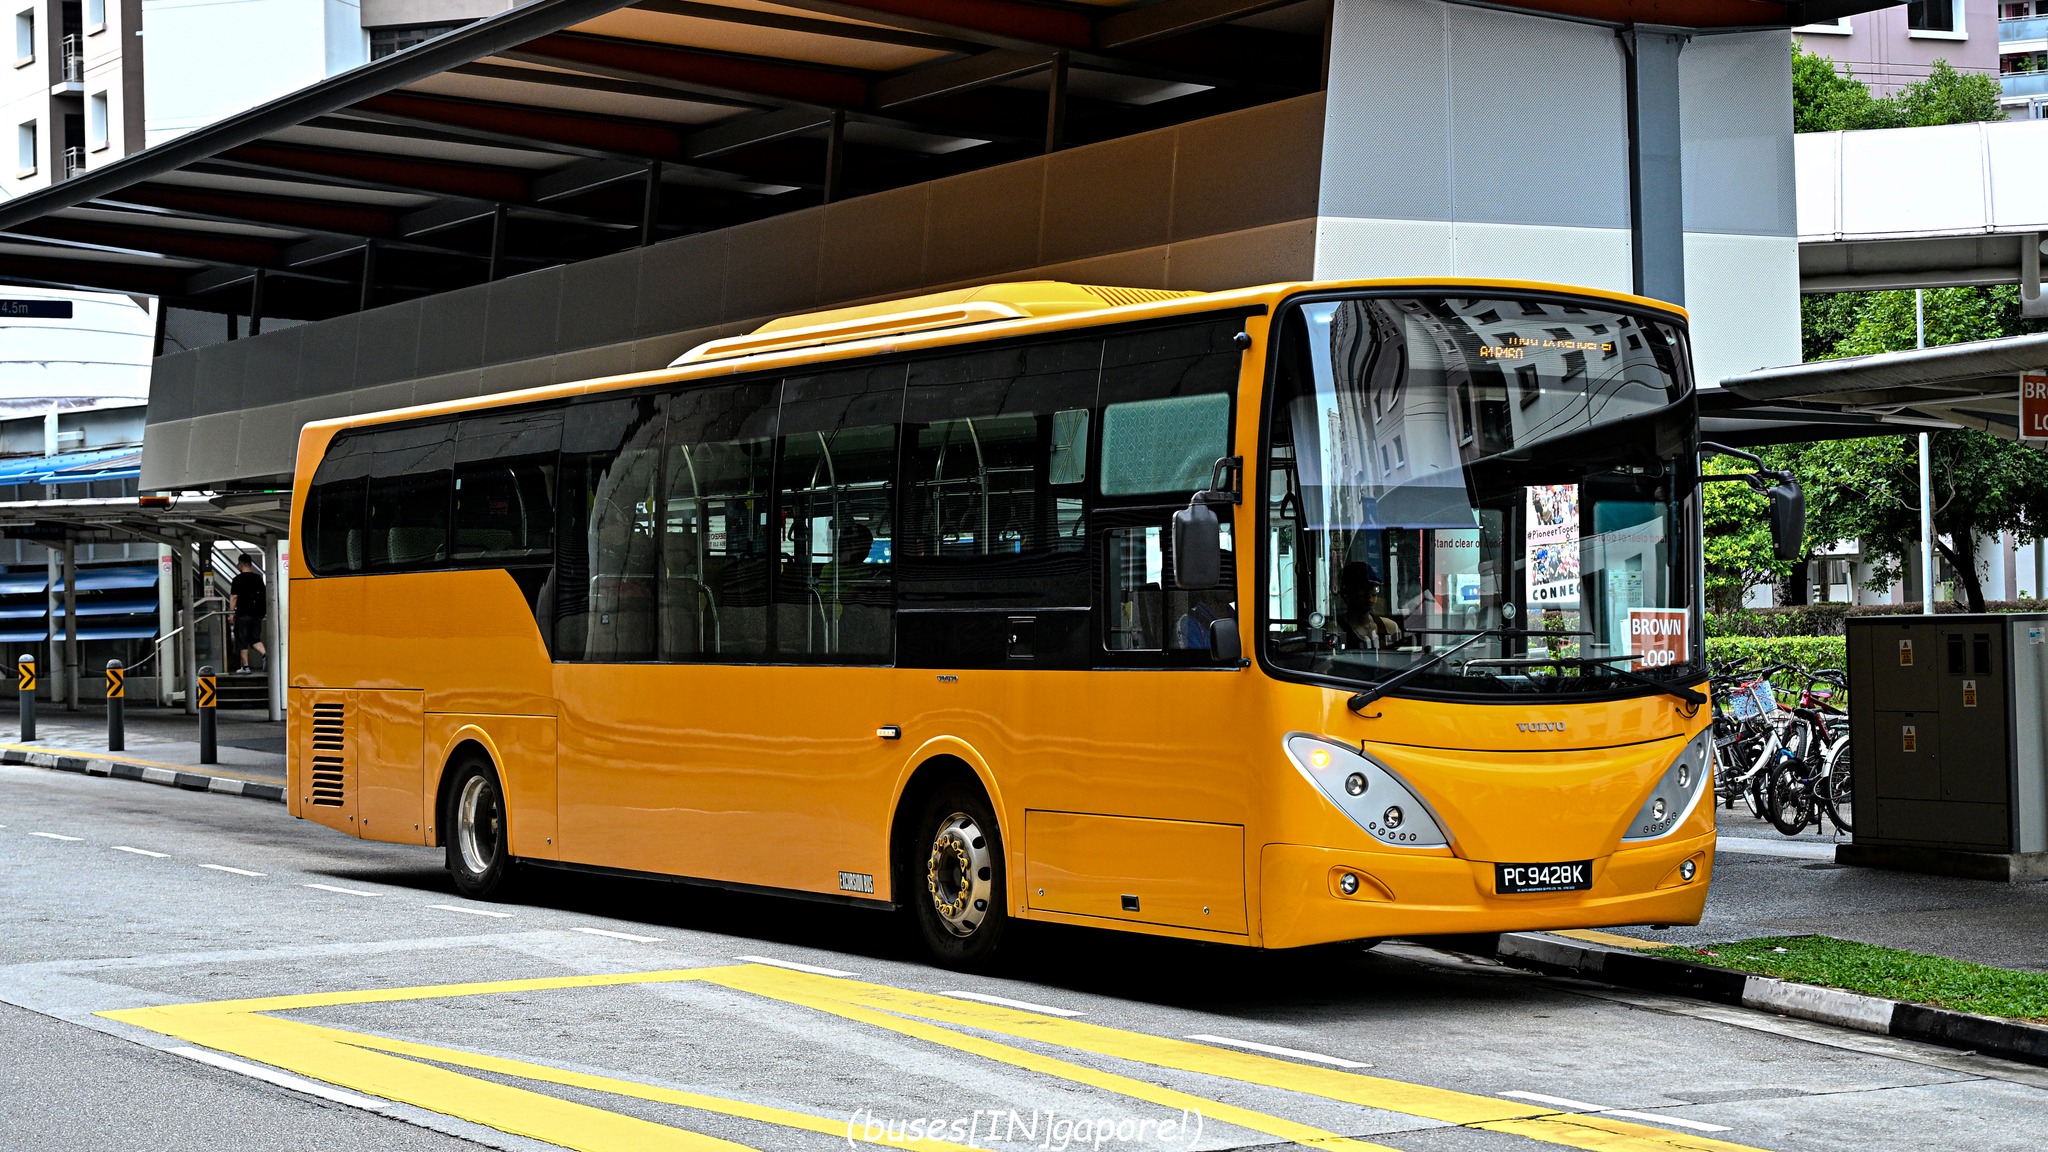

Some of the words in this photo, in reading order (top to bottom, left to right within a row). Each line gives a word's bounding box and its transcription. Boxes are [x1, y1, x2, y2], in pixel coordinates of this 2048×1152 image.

[1, 301, 29, 314] 4.5m
[2025, 382, 2048, 399] BR
[1455, 538, 1473, 548] clear
[1632, 618, 1682, 636] BROWN
[1641, 649, 1675, 668] LOOP
[1516, 722, 1566, 732] VOLVO
[863, 874, 874, 894] BUS
[1503, 865, 1584, 886] PC9428K
